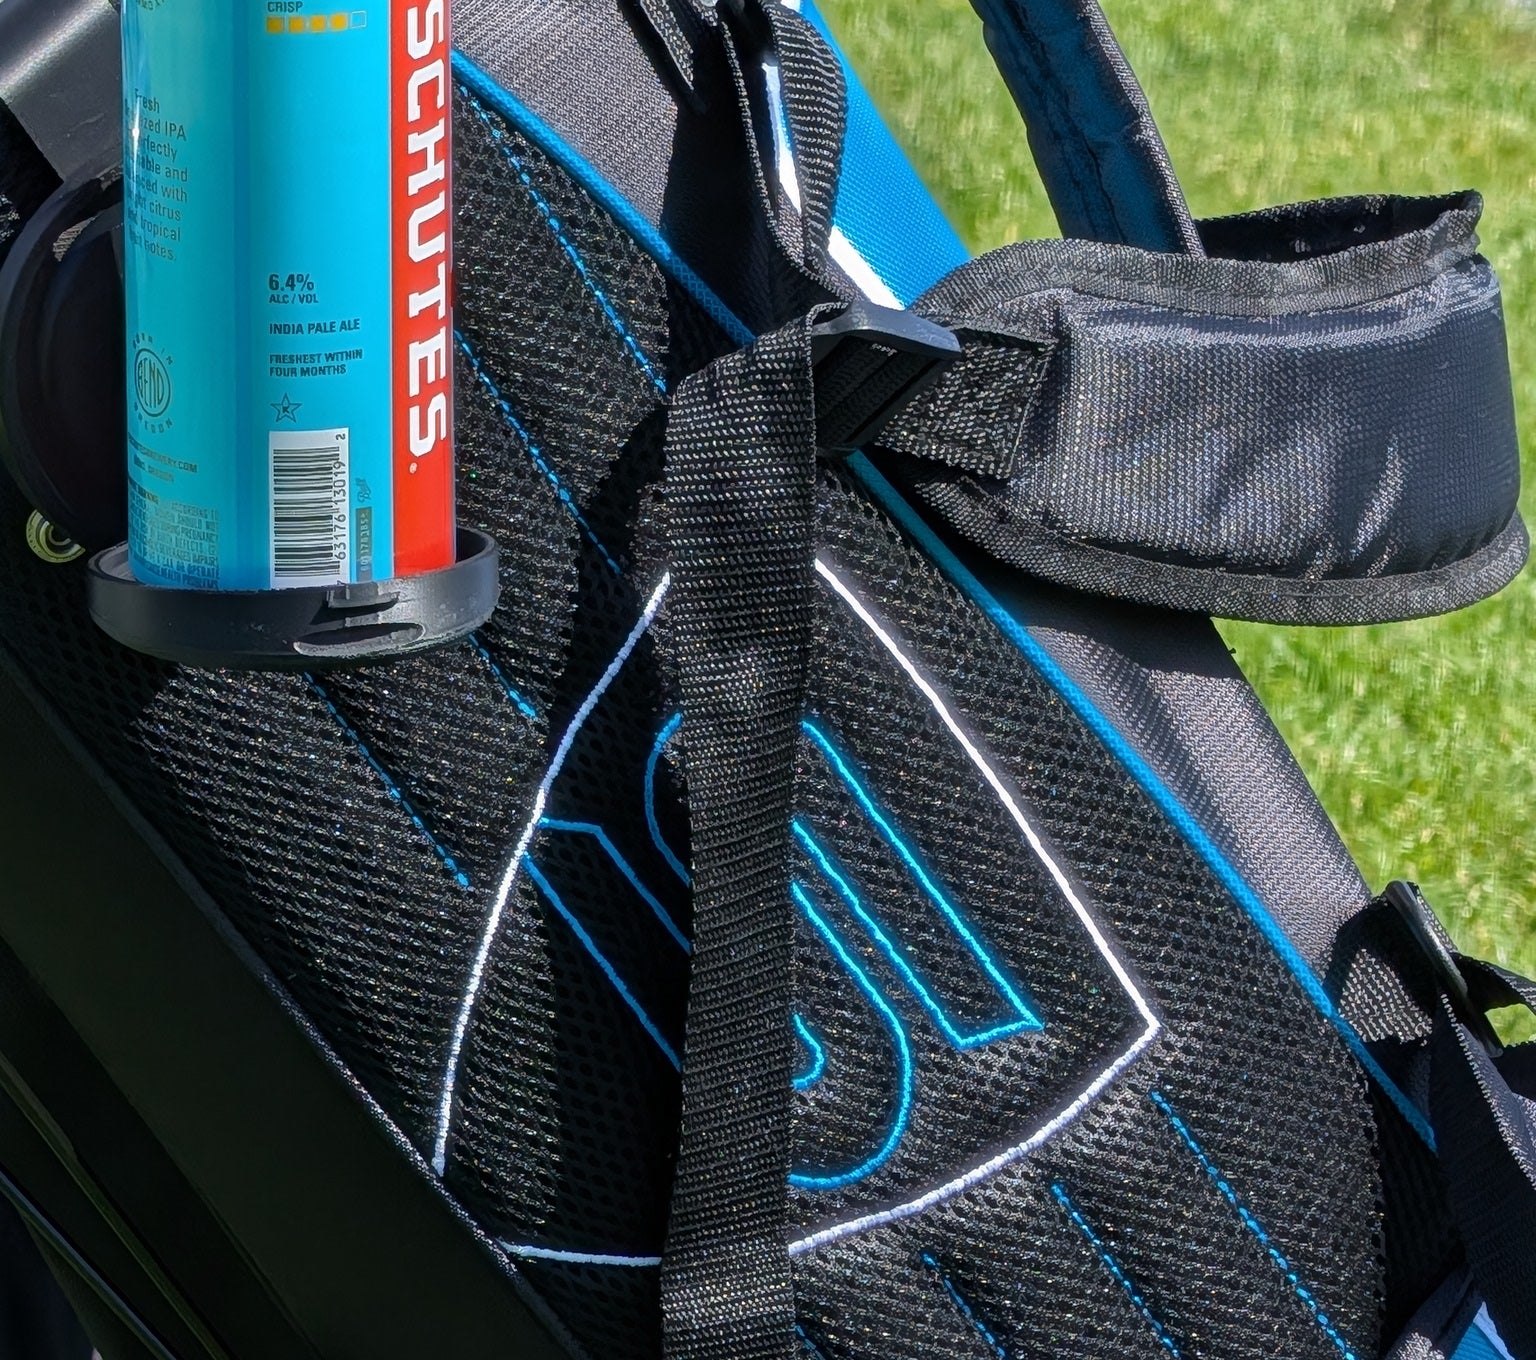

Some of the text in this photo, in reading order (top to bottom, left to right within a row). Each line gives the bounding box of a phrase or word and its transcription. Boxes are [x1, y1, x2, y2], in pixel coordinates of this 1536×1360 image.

[267, 1, 303, 13] CRISP
[135, 89, 160, 113] Fesh
[165, 120, 187, 141] IPA
[165, 166, 188, 183] and
[161, 184, 188, 203] with
[149, 200, 181, 222] citrus
[140, 213, 181, 242] tropical
[269, 274, 315, 291] 6.4%
[269, 318, 360, 335] INDIA PALE ALE
[269, 349, 363, 364] FRESHEST WITHIN
[269, 363, 346, 377] FOUR MONTHS
[137, 357, 165, 408] BEND
[335, 433, 346, 441] 2
[333, 461, 346, 506] 13019
[334, 514, 346, 560] 63176
